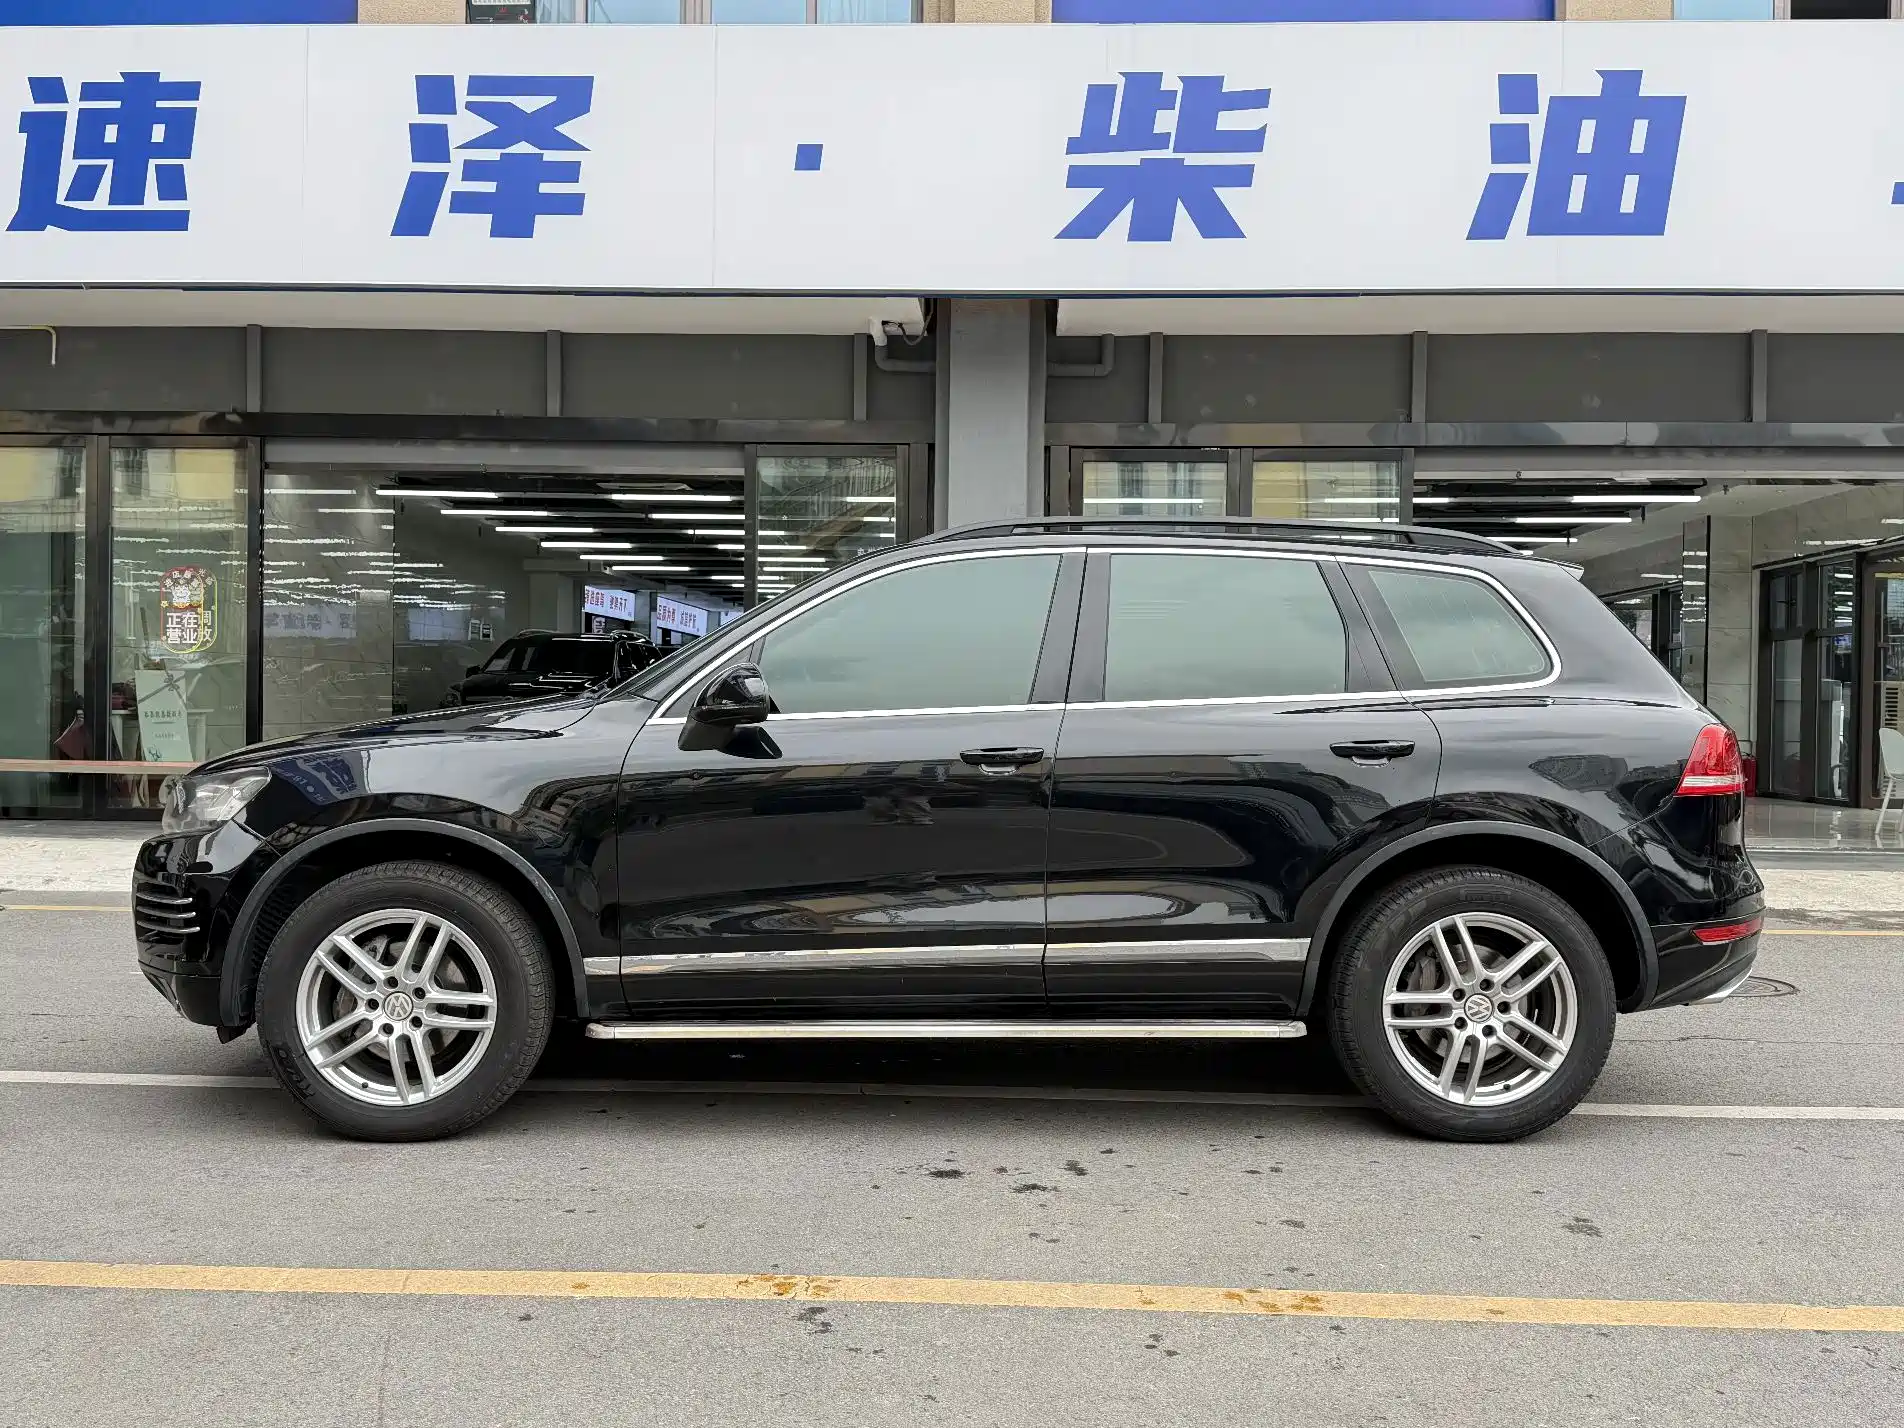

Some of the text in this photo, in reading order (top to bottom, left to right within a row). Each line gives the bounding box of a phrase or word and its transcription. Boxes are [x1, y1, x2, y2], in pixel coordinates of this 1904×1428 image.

[8, 70, 1904, 241] 速泽·柴油
[166, 611, 198, 628] 正在
[166, 627, 198, 644] 营业
